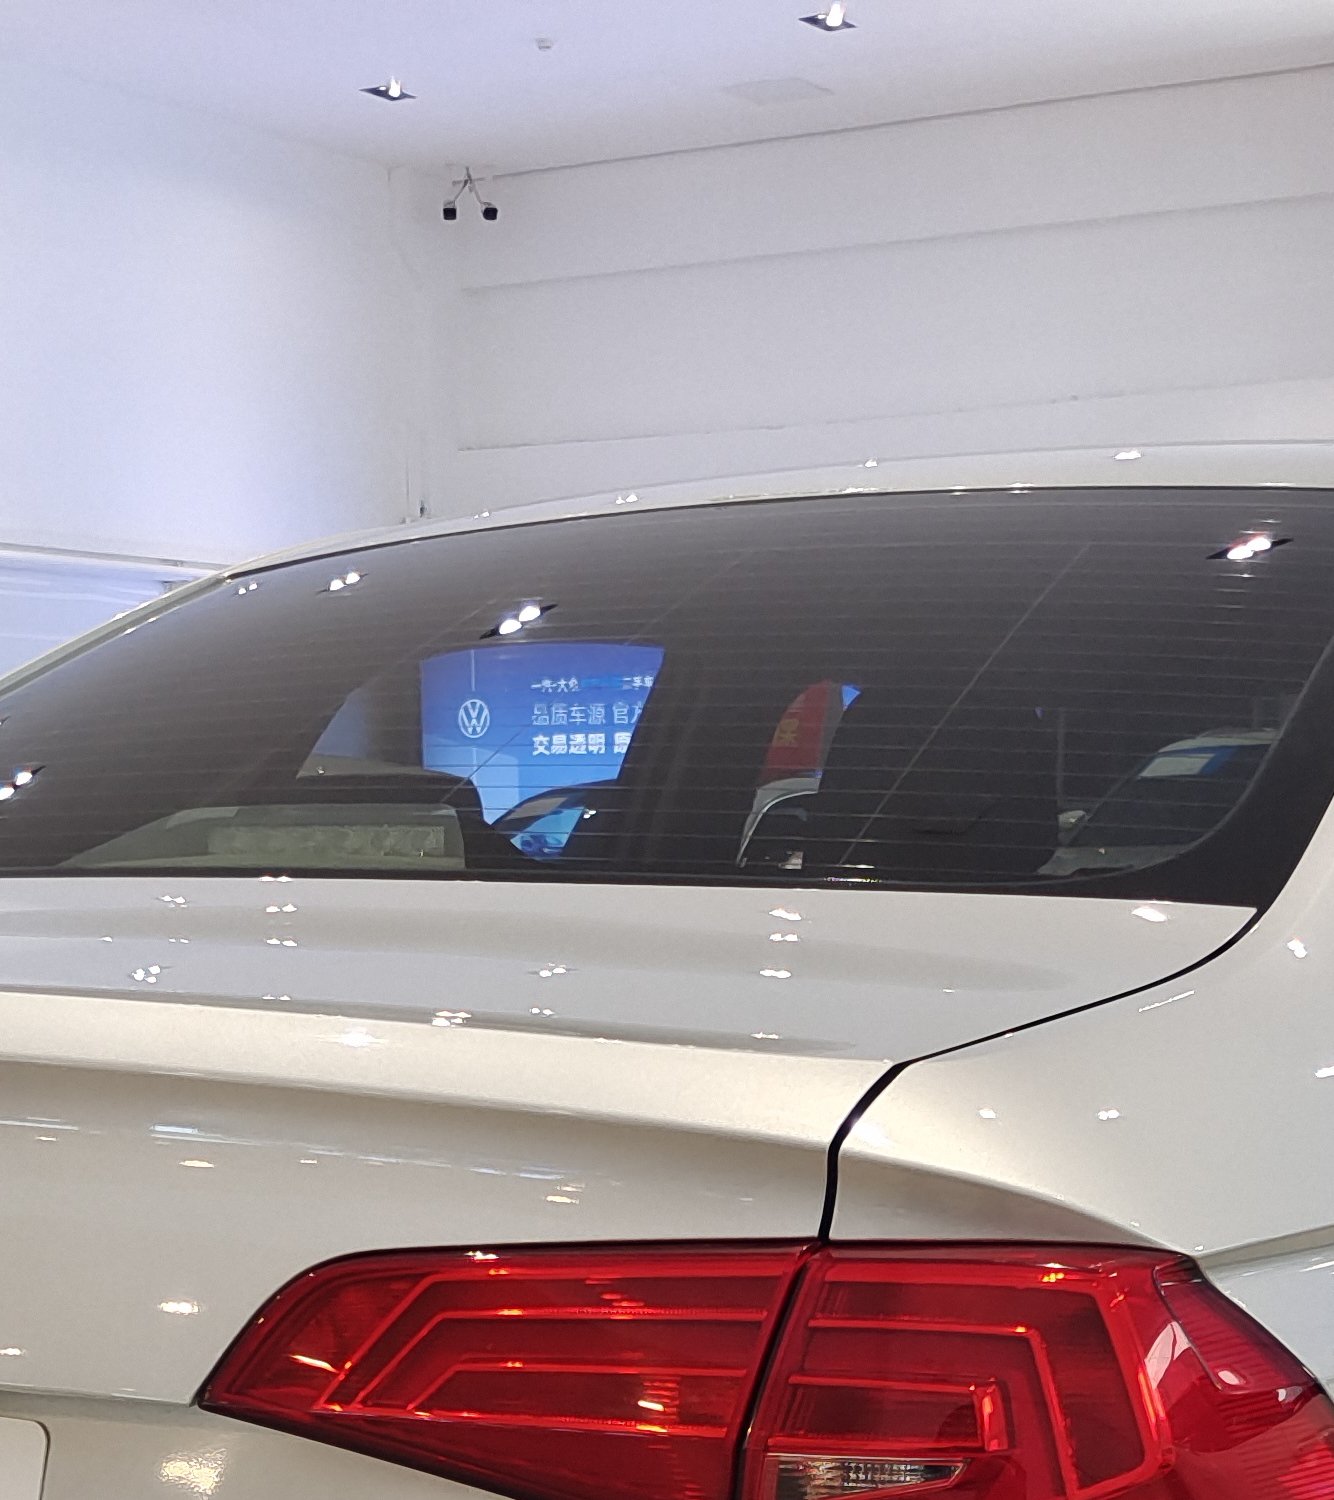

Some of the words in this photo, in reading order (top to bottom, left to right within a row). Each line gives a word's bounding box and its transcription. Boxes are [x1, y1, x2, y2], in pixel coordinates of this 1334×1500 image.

[532, 703, 607, 726] 品质车源
[531, 733, 606, 756] 交易透明
